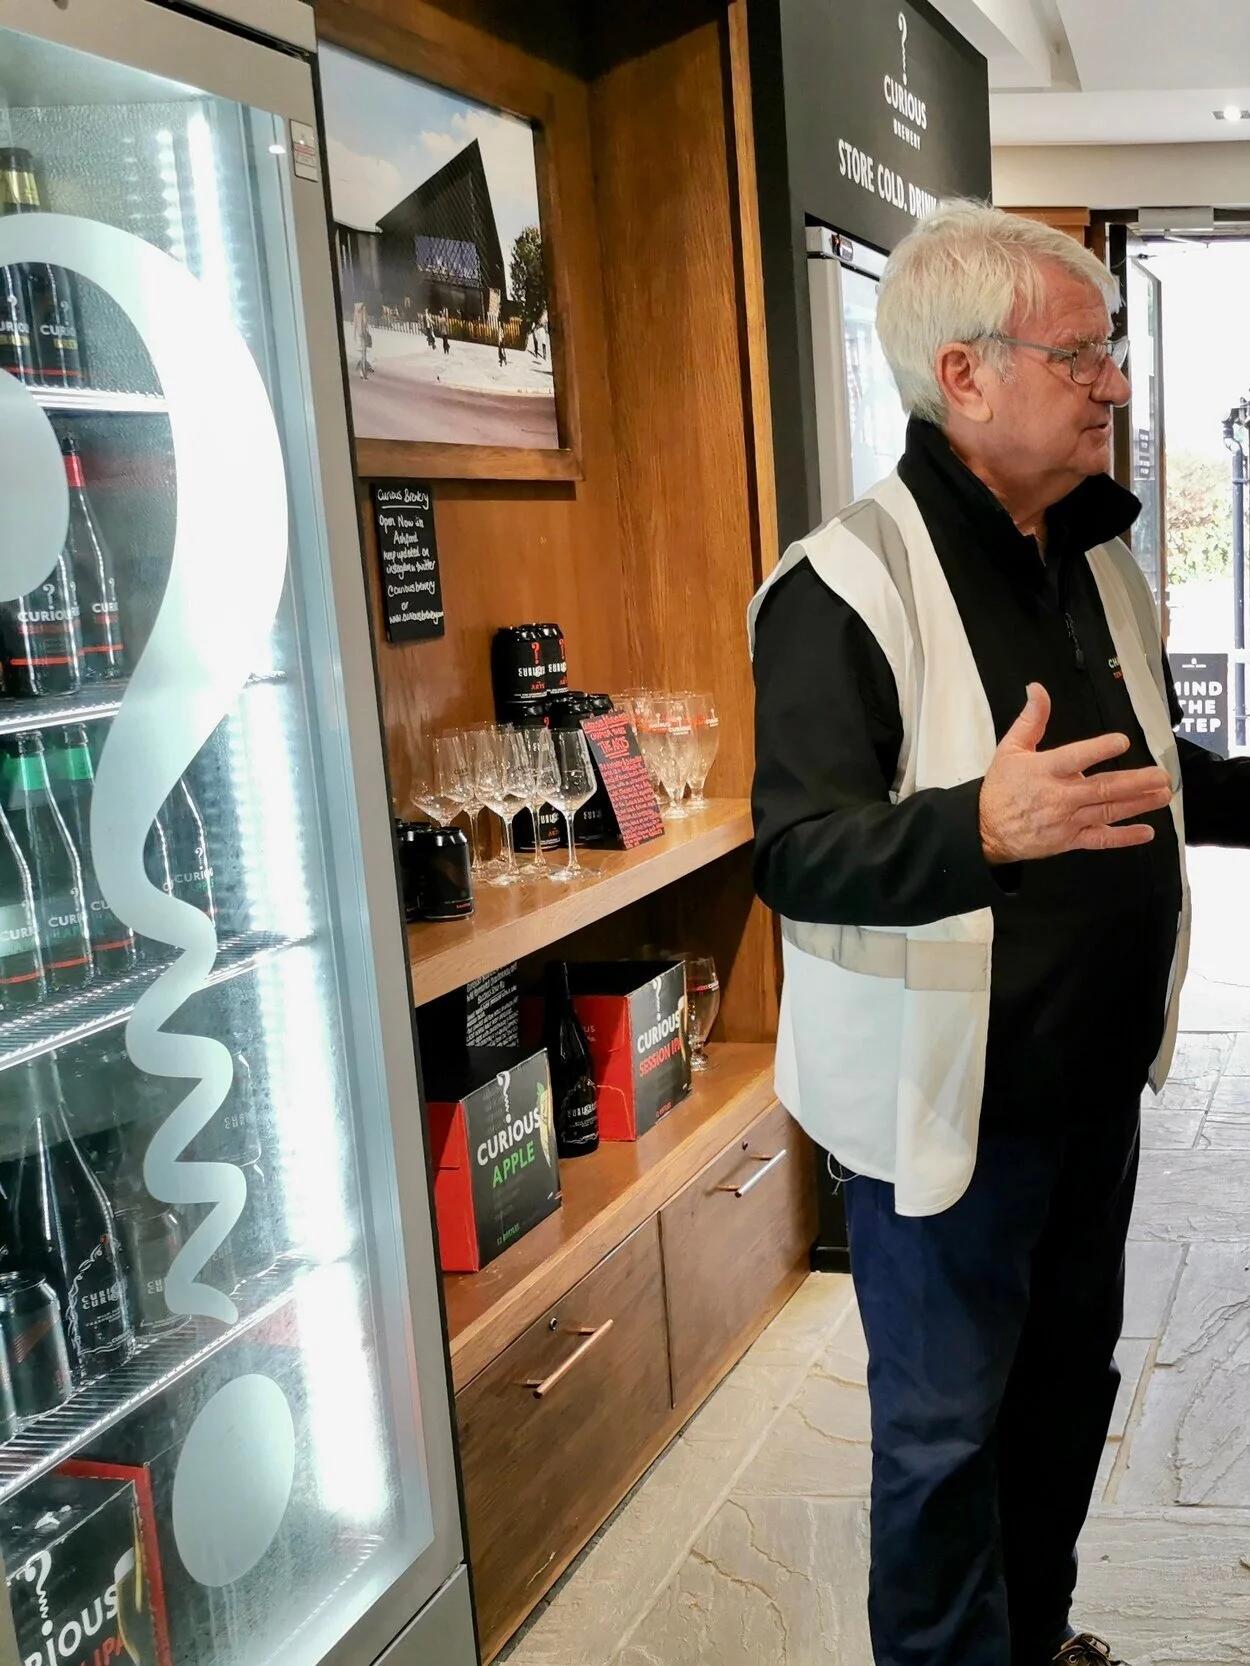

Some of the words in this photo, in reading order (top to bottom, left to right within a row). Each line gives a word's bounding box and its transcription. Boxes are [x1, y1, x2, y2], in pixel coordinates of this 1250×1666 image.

[883, 74, 927, 130] CURIOUS
[893, 118, 921, 150] BREWERY
[838, 138, 875, 193] STORE
[877, 163, 908, 212] COLD.
[379, 515, 396, 534] Open
[397, 515, 414, 528] Now
[1173, 718, 1221, 733] TEP
[637, 1010, 680, 1054] CURIOUS
[639, 1045, 671, 1078] SESSION
[477, 1107, 541, 1166] CURIOUS
[492, 1141, 536, 1189] APPLE
